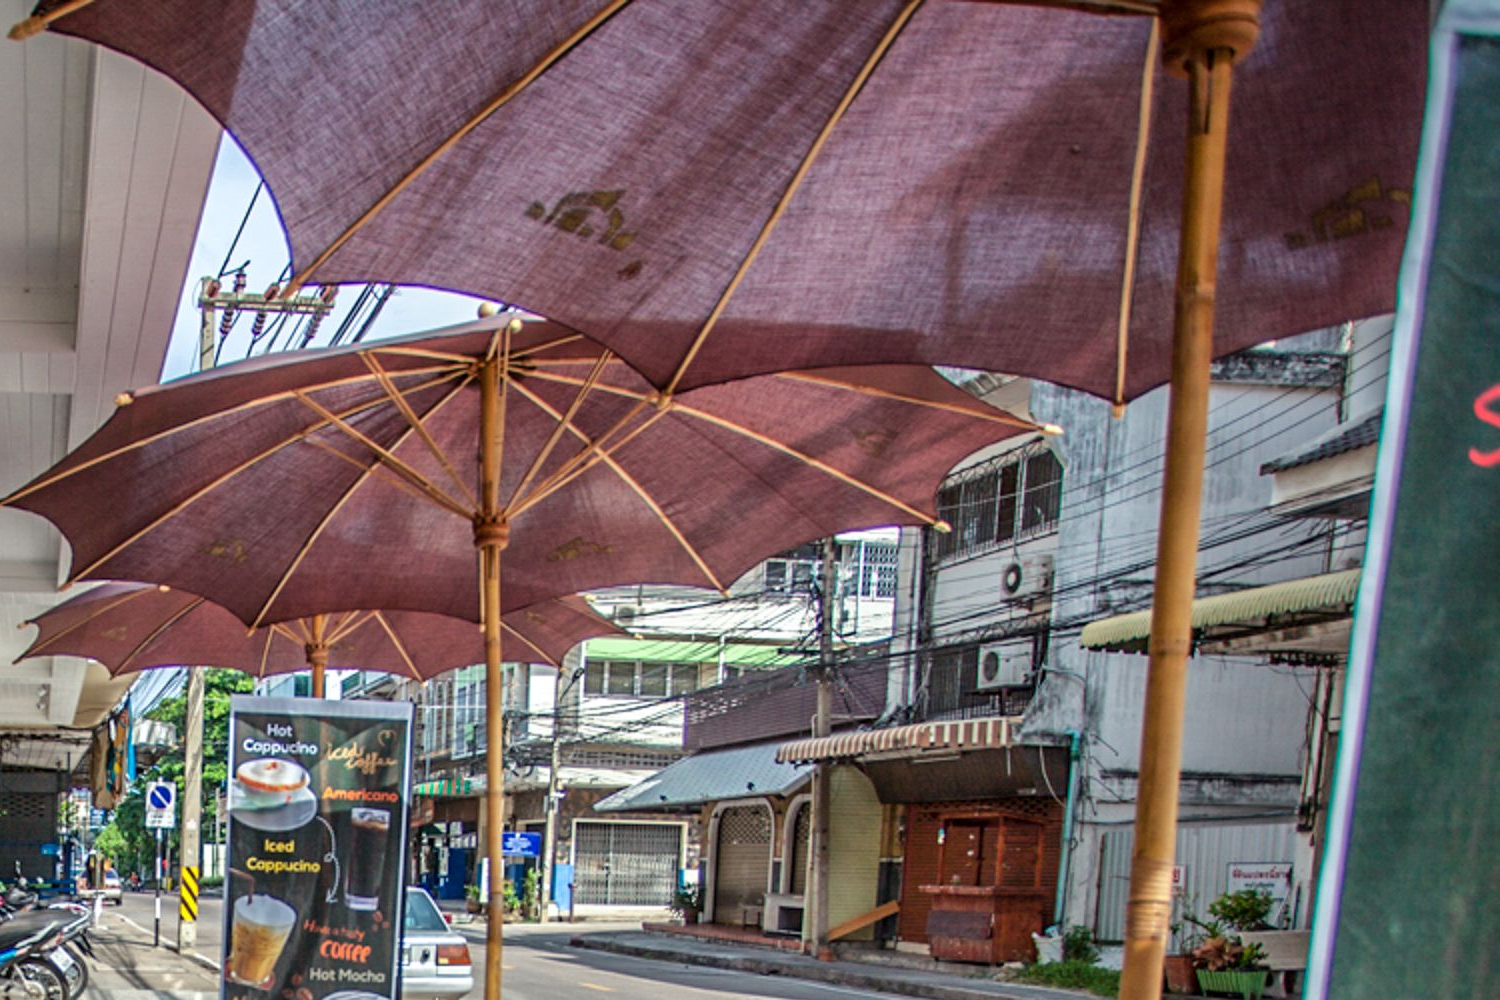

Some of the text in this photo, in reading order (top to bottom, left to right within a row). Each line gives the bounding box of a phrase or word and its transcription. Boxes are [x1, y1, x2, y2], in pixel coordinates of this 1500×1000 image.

[266, 723, 293, 738] Hot
[242, 738, 318, 756] Cappucino
[322, 786, 399, 803] Americano
[264, 839, 295, 853] Iced
[246, 857, 321, 873] Cappucino
[309, 968, 386, 983] Hot Mocha
